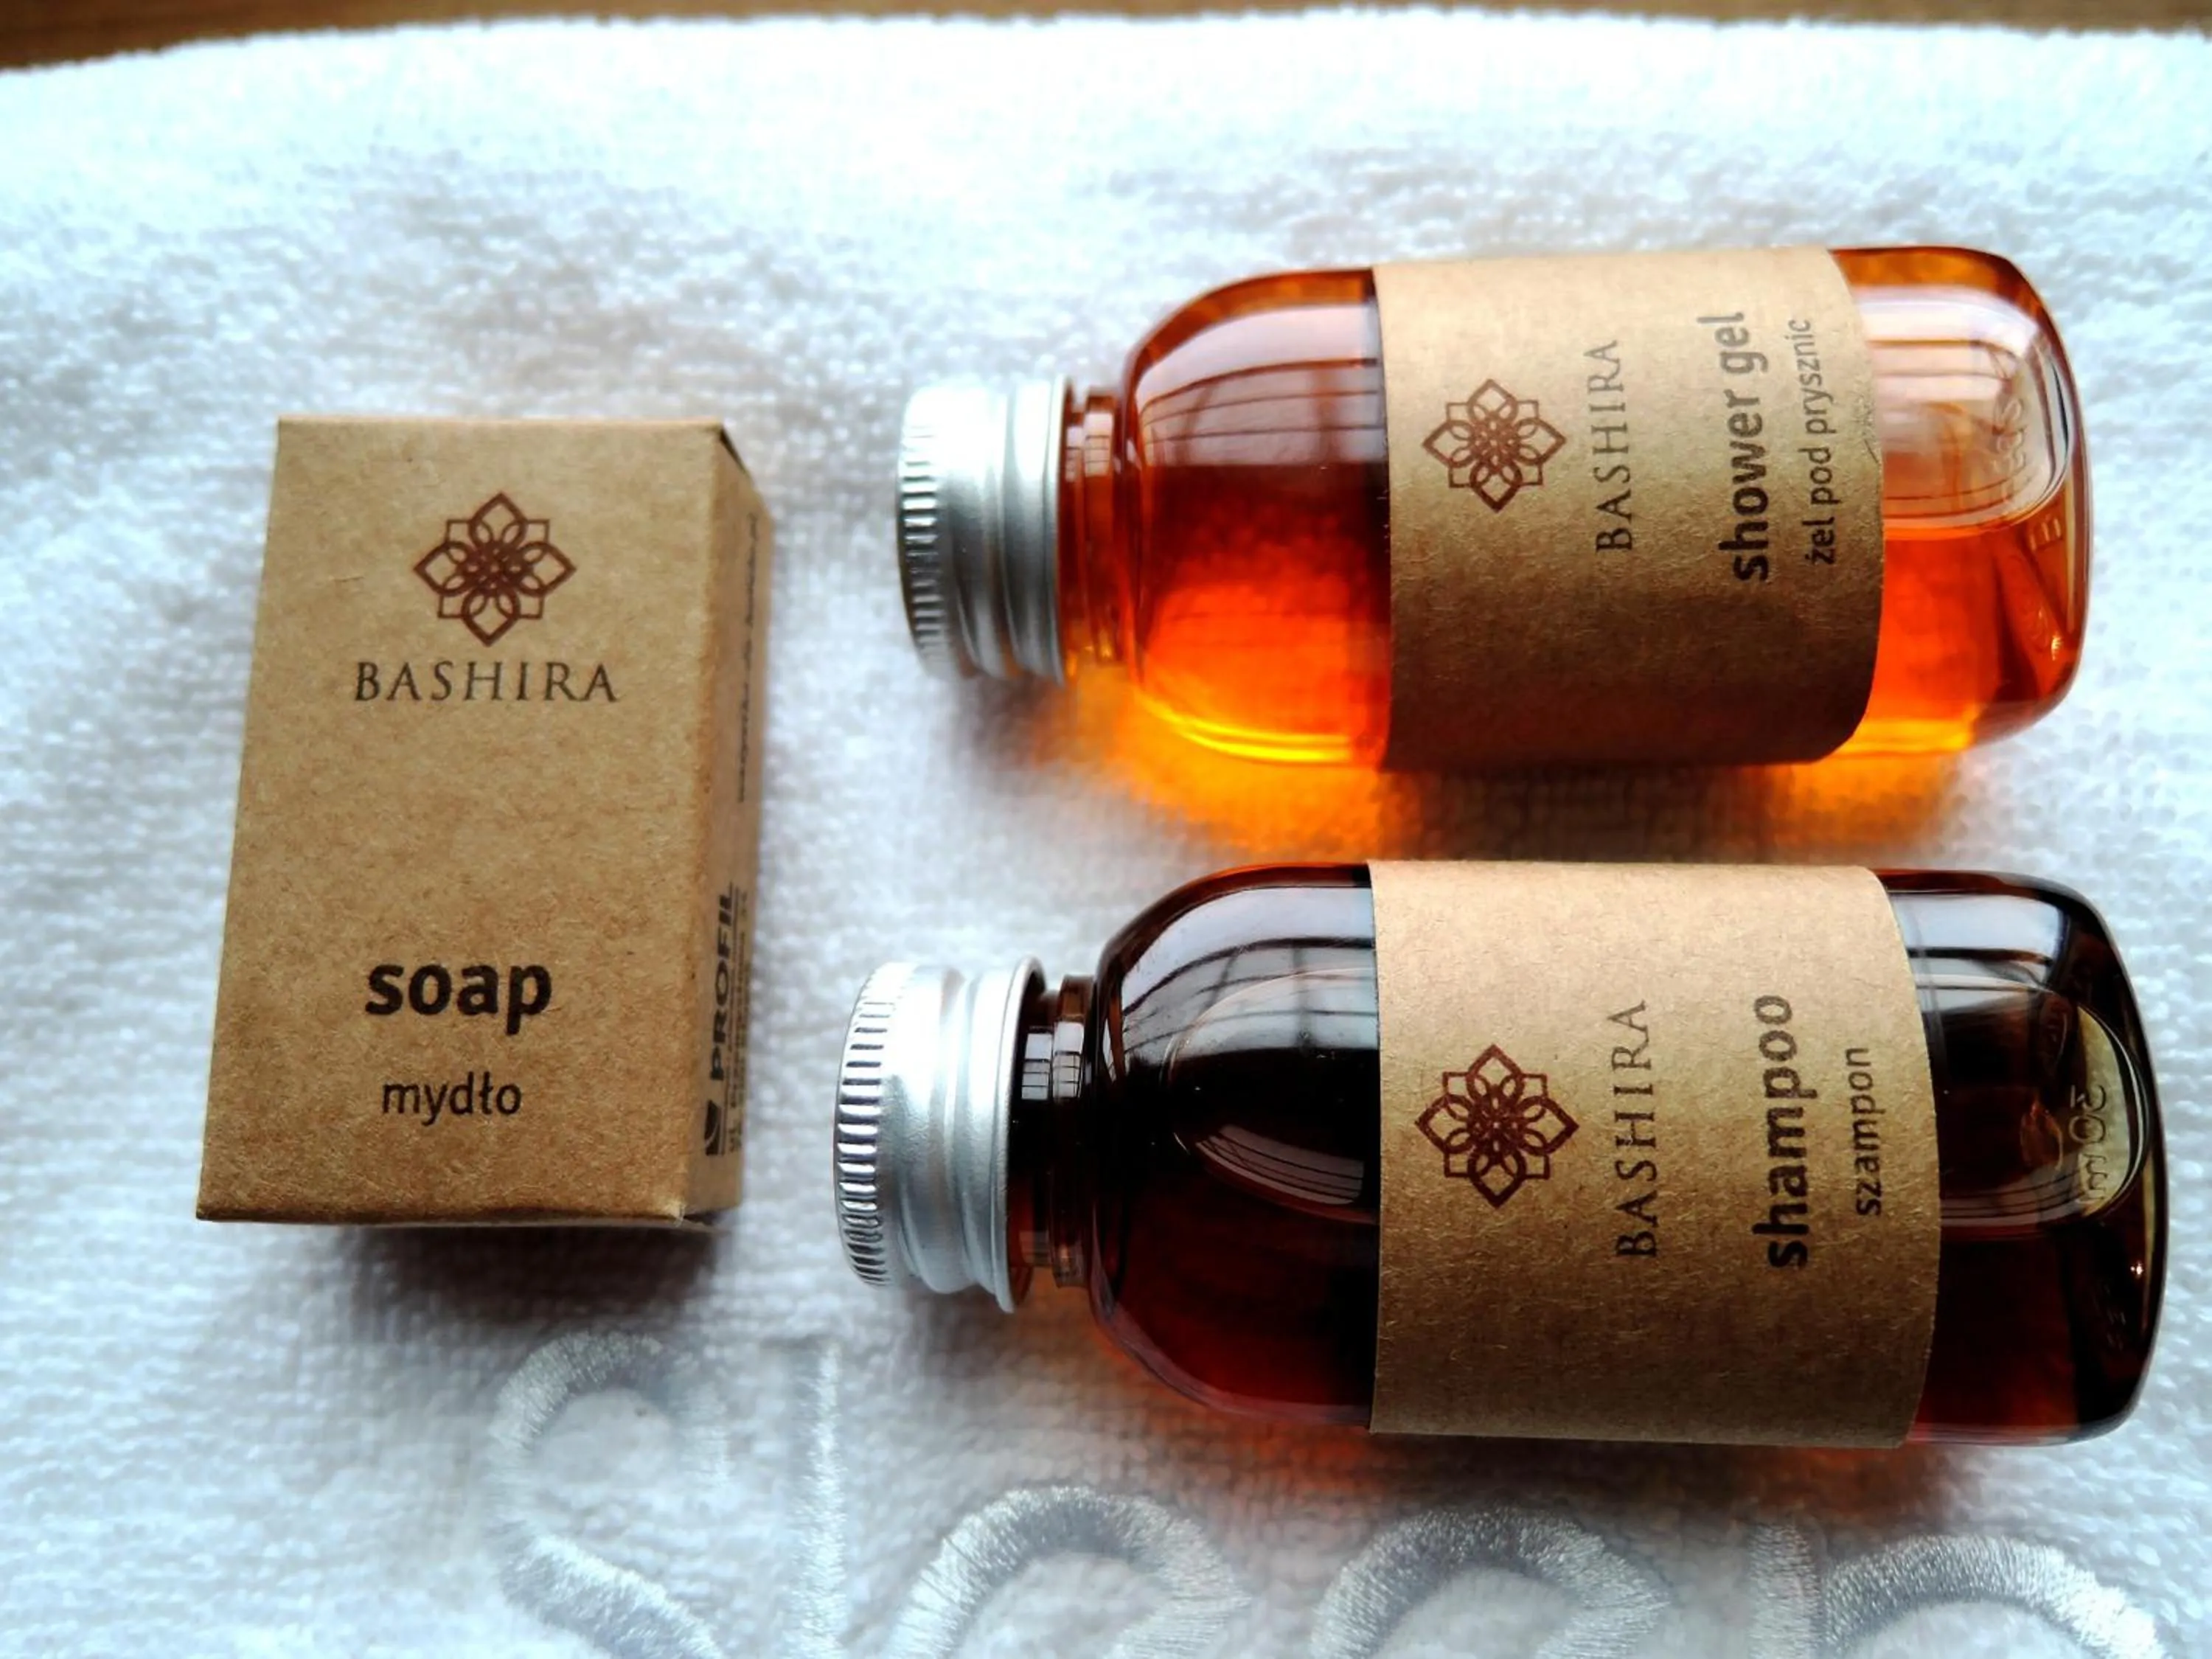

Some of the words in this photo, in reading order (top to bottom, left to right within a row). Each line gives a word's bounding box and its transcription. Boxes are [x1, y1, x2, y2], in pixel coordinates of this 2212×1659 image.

[1696, 311, 1769, 375] gel
[1785, 318, 1837, 436] prysznic
[1583, 339, 1633, 552] BASHIRA
[1718, 389, 1770, 582] shower
[1798, 448, 1841, 507] pod
[1801, 517, 1837, 566] żel
[354, 660, 618, 703] BASHIRA
[365, 962, 553, 1036] soap
[711, 883, 732, 1079] PROFIL
[381, 1072, 522, 1126] mydło
[1607, 1000, 1658, 1259] BASHIRA
[1752, 994, 1818, 1270] shampoo
[1843, 1047, 1886, 1217] szampon
